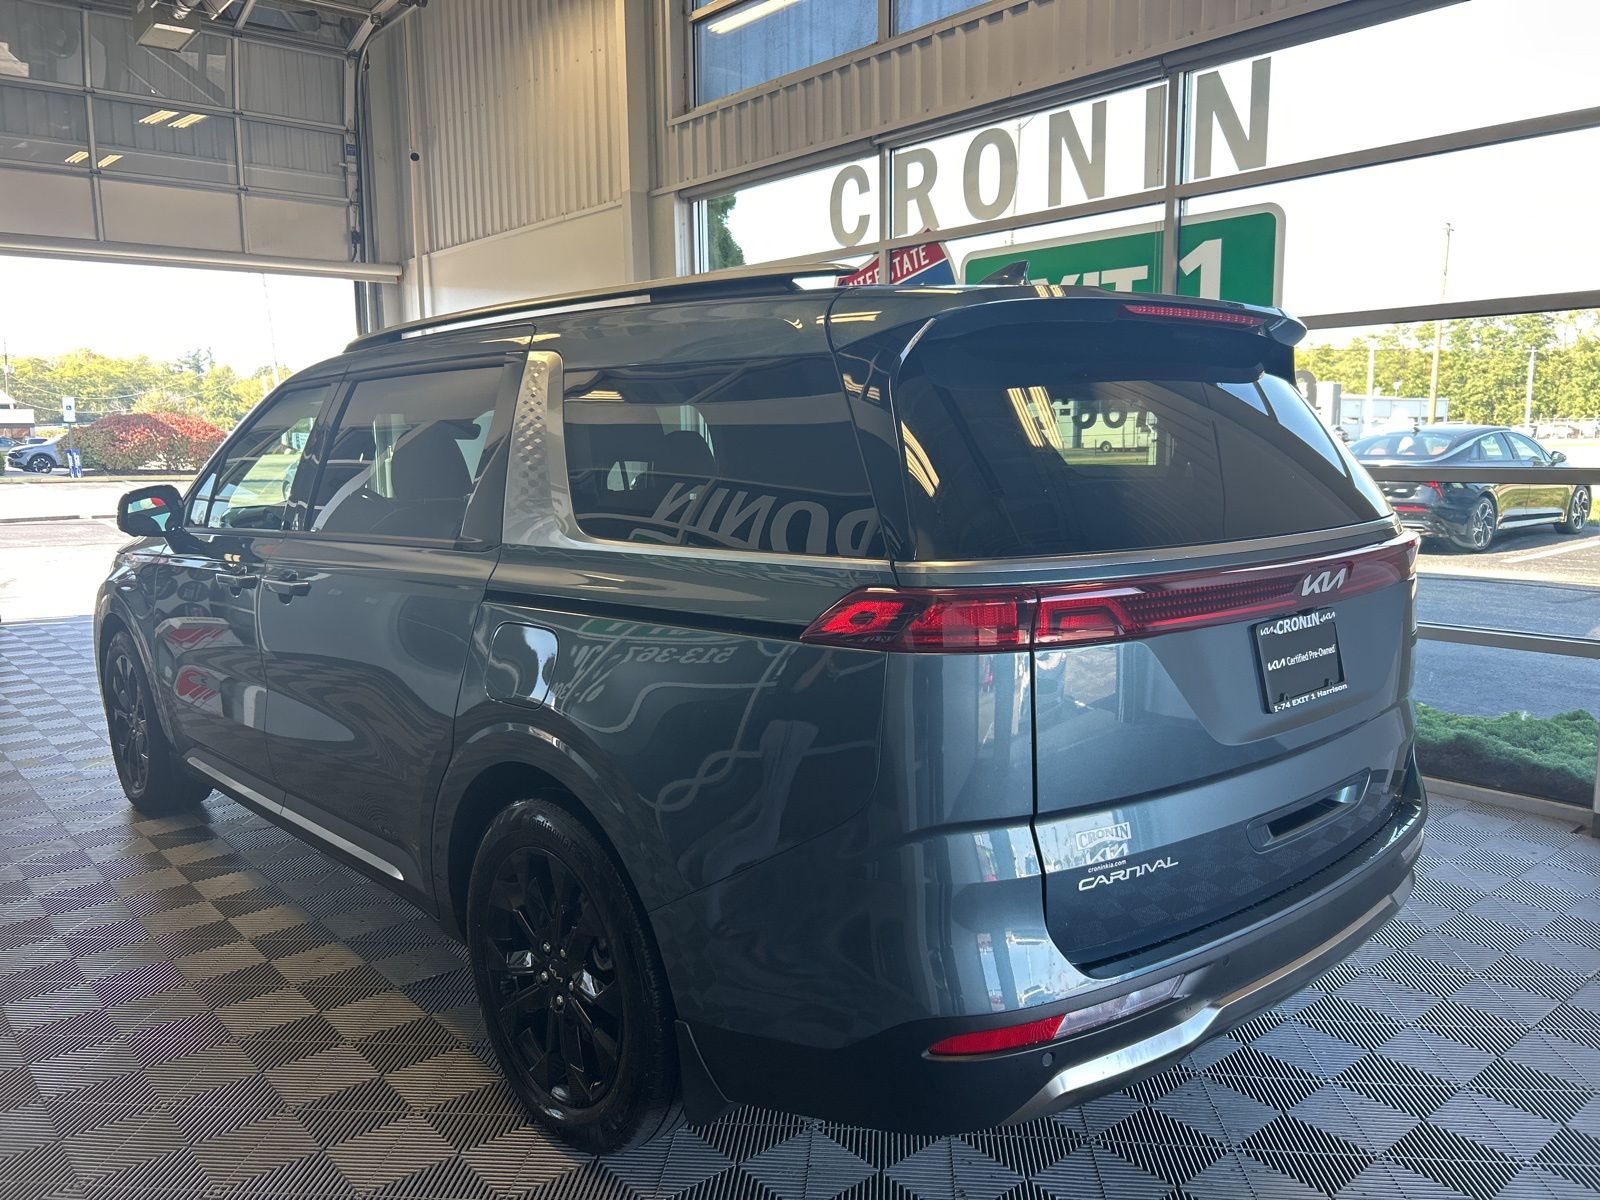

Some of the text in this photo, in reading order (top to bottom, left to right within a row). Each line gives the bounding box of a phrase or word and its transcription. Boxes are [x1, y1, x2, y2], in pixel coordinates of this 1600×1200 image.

[830, 56, 1271, 246] CRONIN
[1276, 612, 1320, 635] CRONIN
[1286, 652, 1309, 666] Certified
[1309, 644, 1336, 660] Pre-Owned
[1274, 683, 1348, 712] I-74 EXIT 1 Harrison
[1079, 823, 1130, 848] CRONIN
[1078, 856, 1179, 891] CARNIVAL
[1087, 859, 1127, 874] croninkia.com
